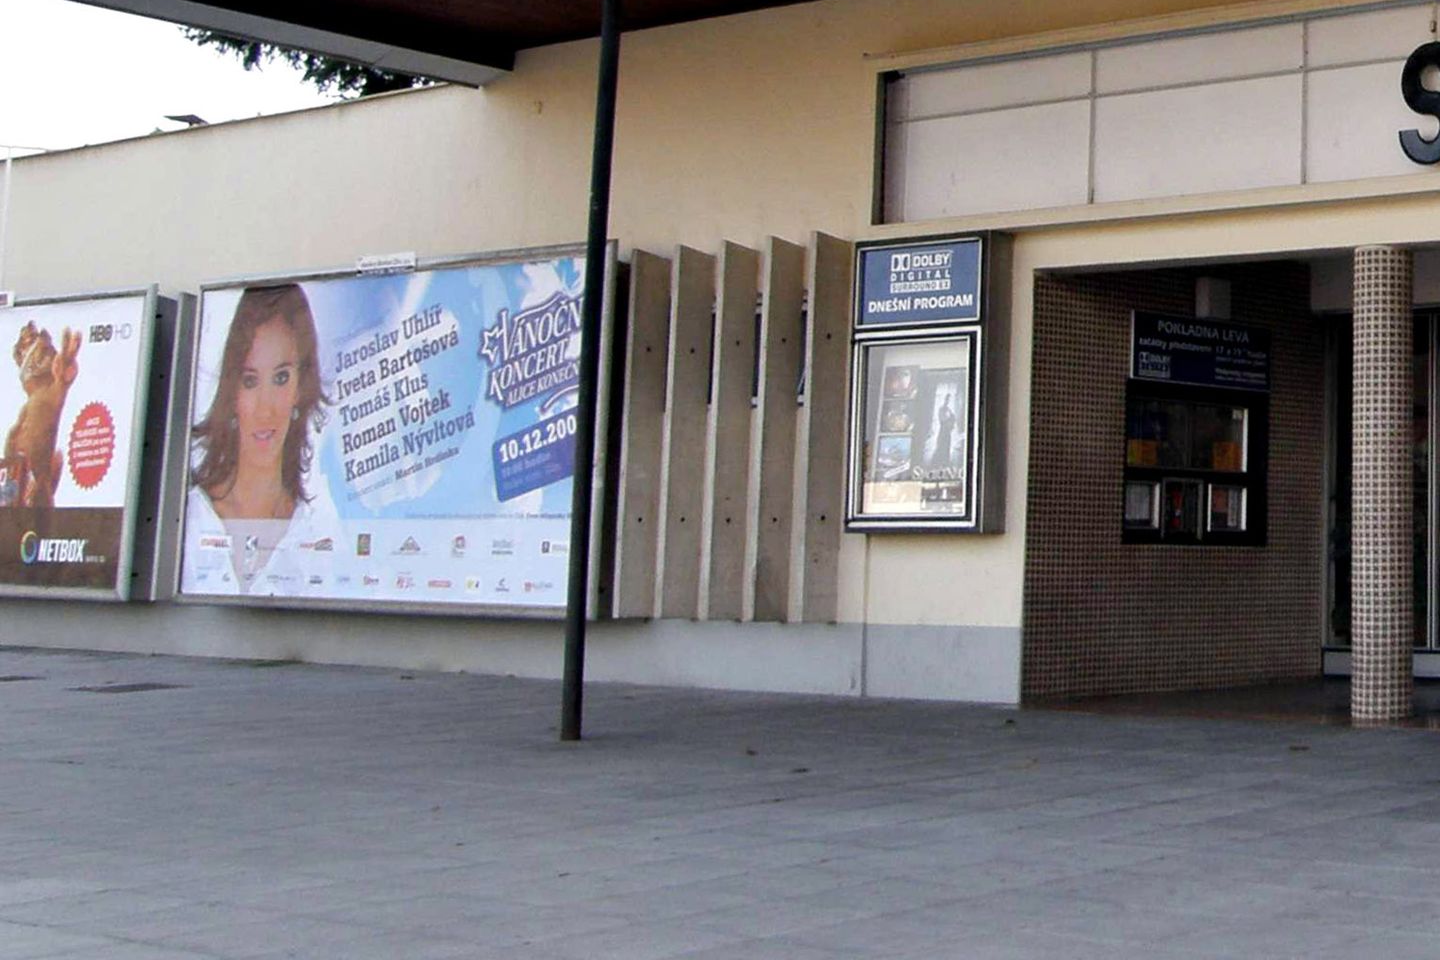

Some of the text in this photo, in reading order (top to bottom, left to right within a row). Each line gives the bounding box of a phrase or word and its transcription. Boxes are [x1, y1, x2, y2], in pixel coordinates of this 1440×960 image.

[890, 269, 951, 282] DIGITAL
[912, 254, 951, 268] DOLBY
[868, 294, 974, 313] DNEŠNÍ PROGRAM
[89, 324, 114, 343] HBO
[335, 303, 443, 373] Jaroslav Uhlíř
[501, 298, 583, 361] VÁNOČN
[1157, 320, 1220, 339] POKLADNA
[336, 324, 460, 401] Iveta Bartošová
[489, 338, 569, 401] KONCERT
[507, 360, 580, 406] ALICE KONEČN
[339, 373, 429, 427] Tomáš Klus
[342, 390, 453, 455] Roman Vojtek
[344, 404, 476, 482] Kamila Nývltová
[499, 414, 577, 463] 10.12.200
[37, 538, 86, 563] NETBOX
